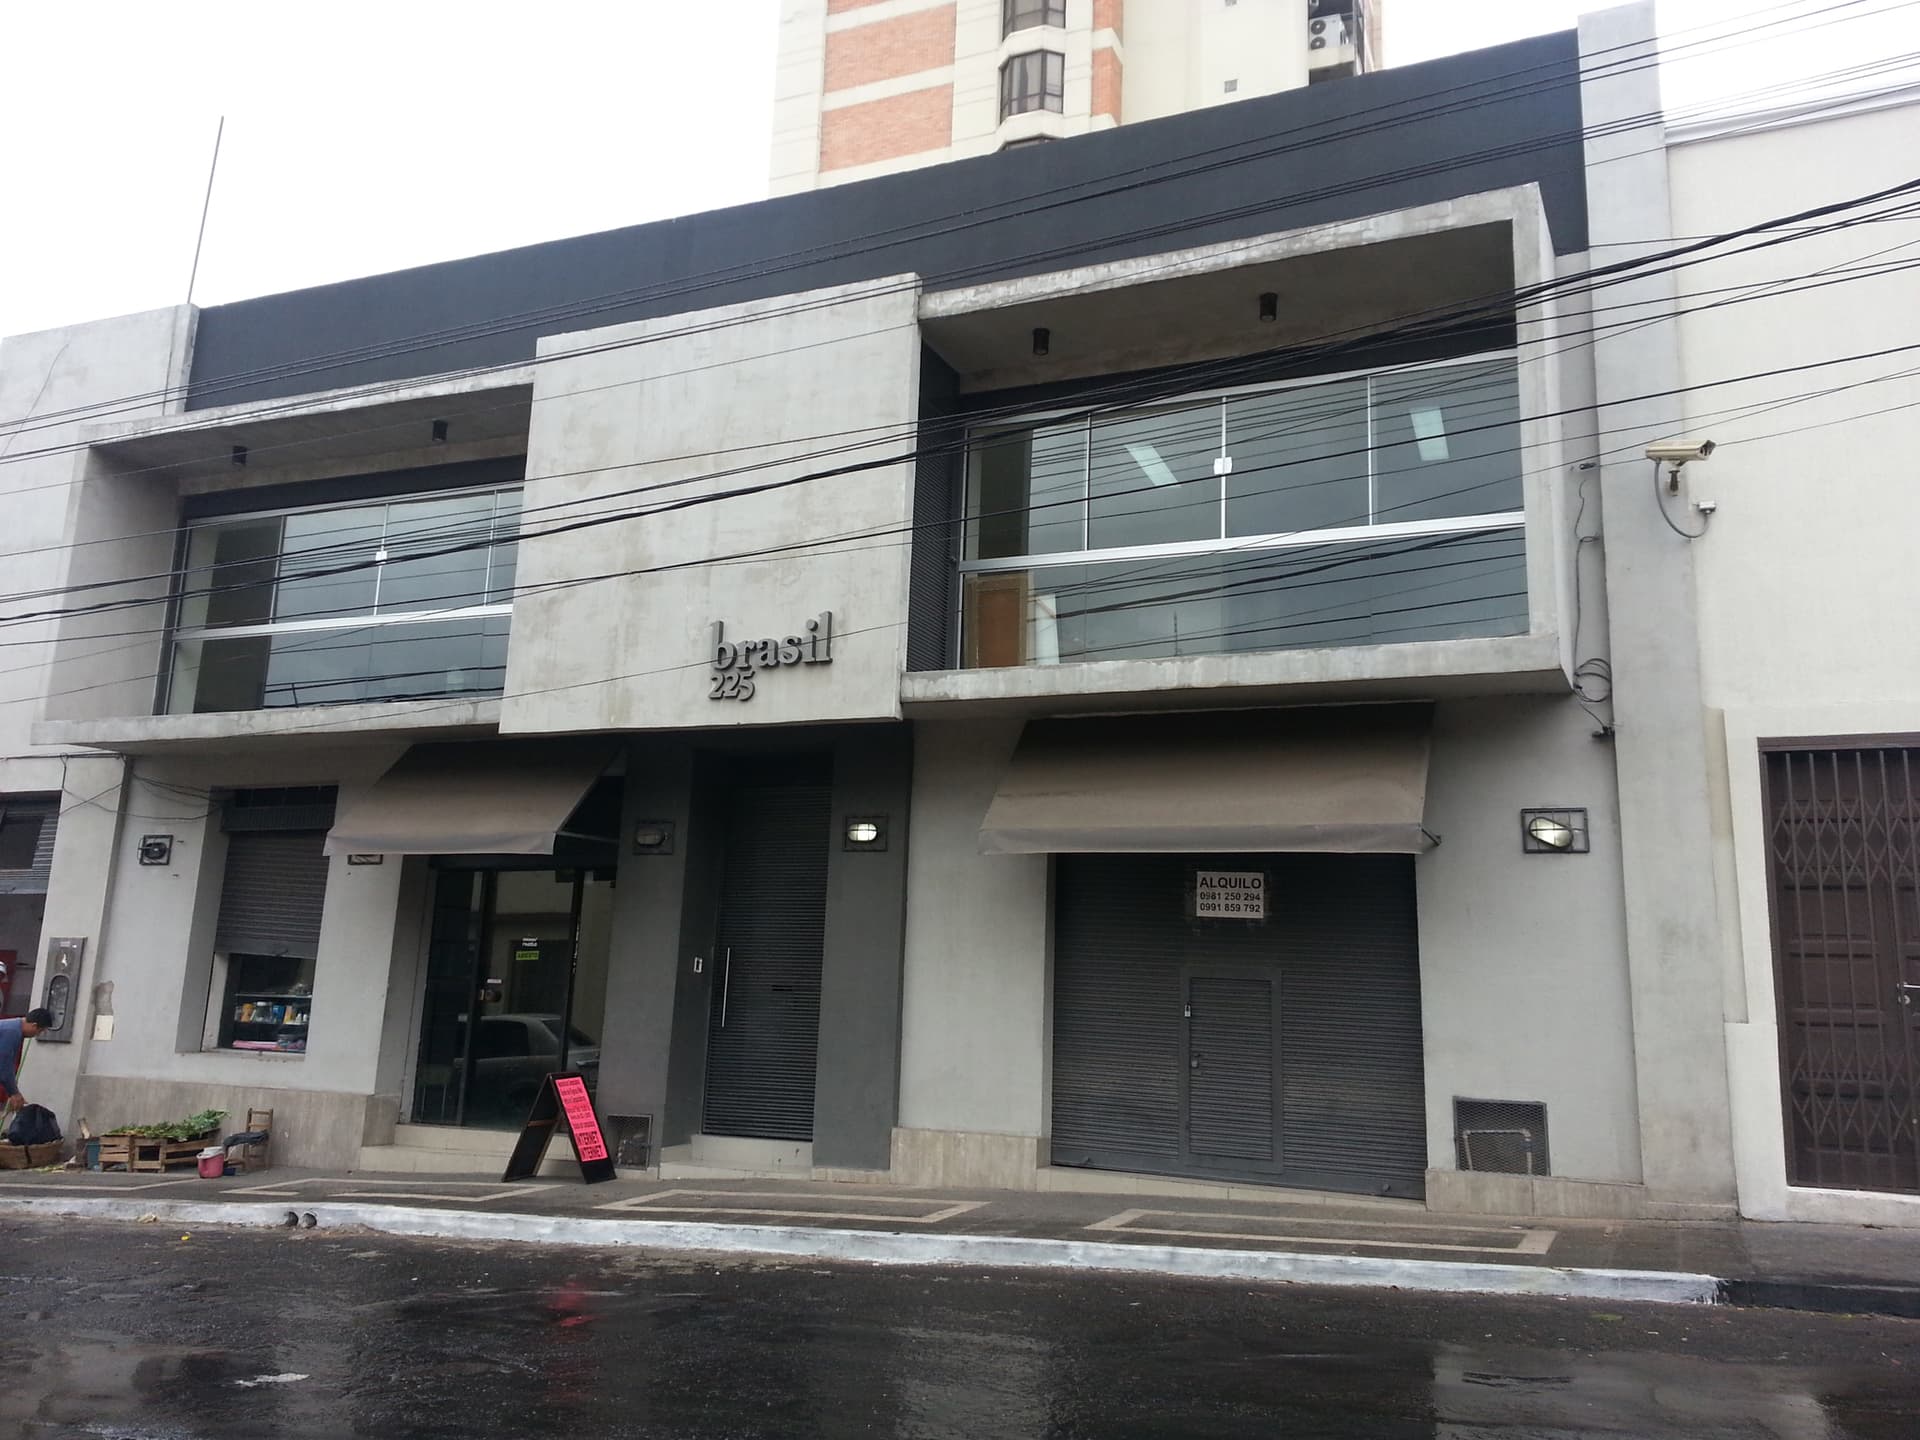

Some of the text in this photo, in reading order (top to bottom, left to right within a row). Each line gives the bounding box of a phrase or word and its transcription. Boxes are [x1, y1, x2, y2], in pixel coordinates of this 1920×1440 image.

[709, 611, 833, 671] brasil
[708, 670, 756, 702] 225
[1200, 877, 1262, 889] ALQUILO
[1200, 891, 1261, 902] 0981 250 294
[1200, 902, 1221, 912] 0991
[1243, 903, 1261, 913] 792
